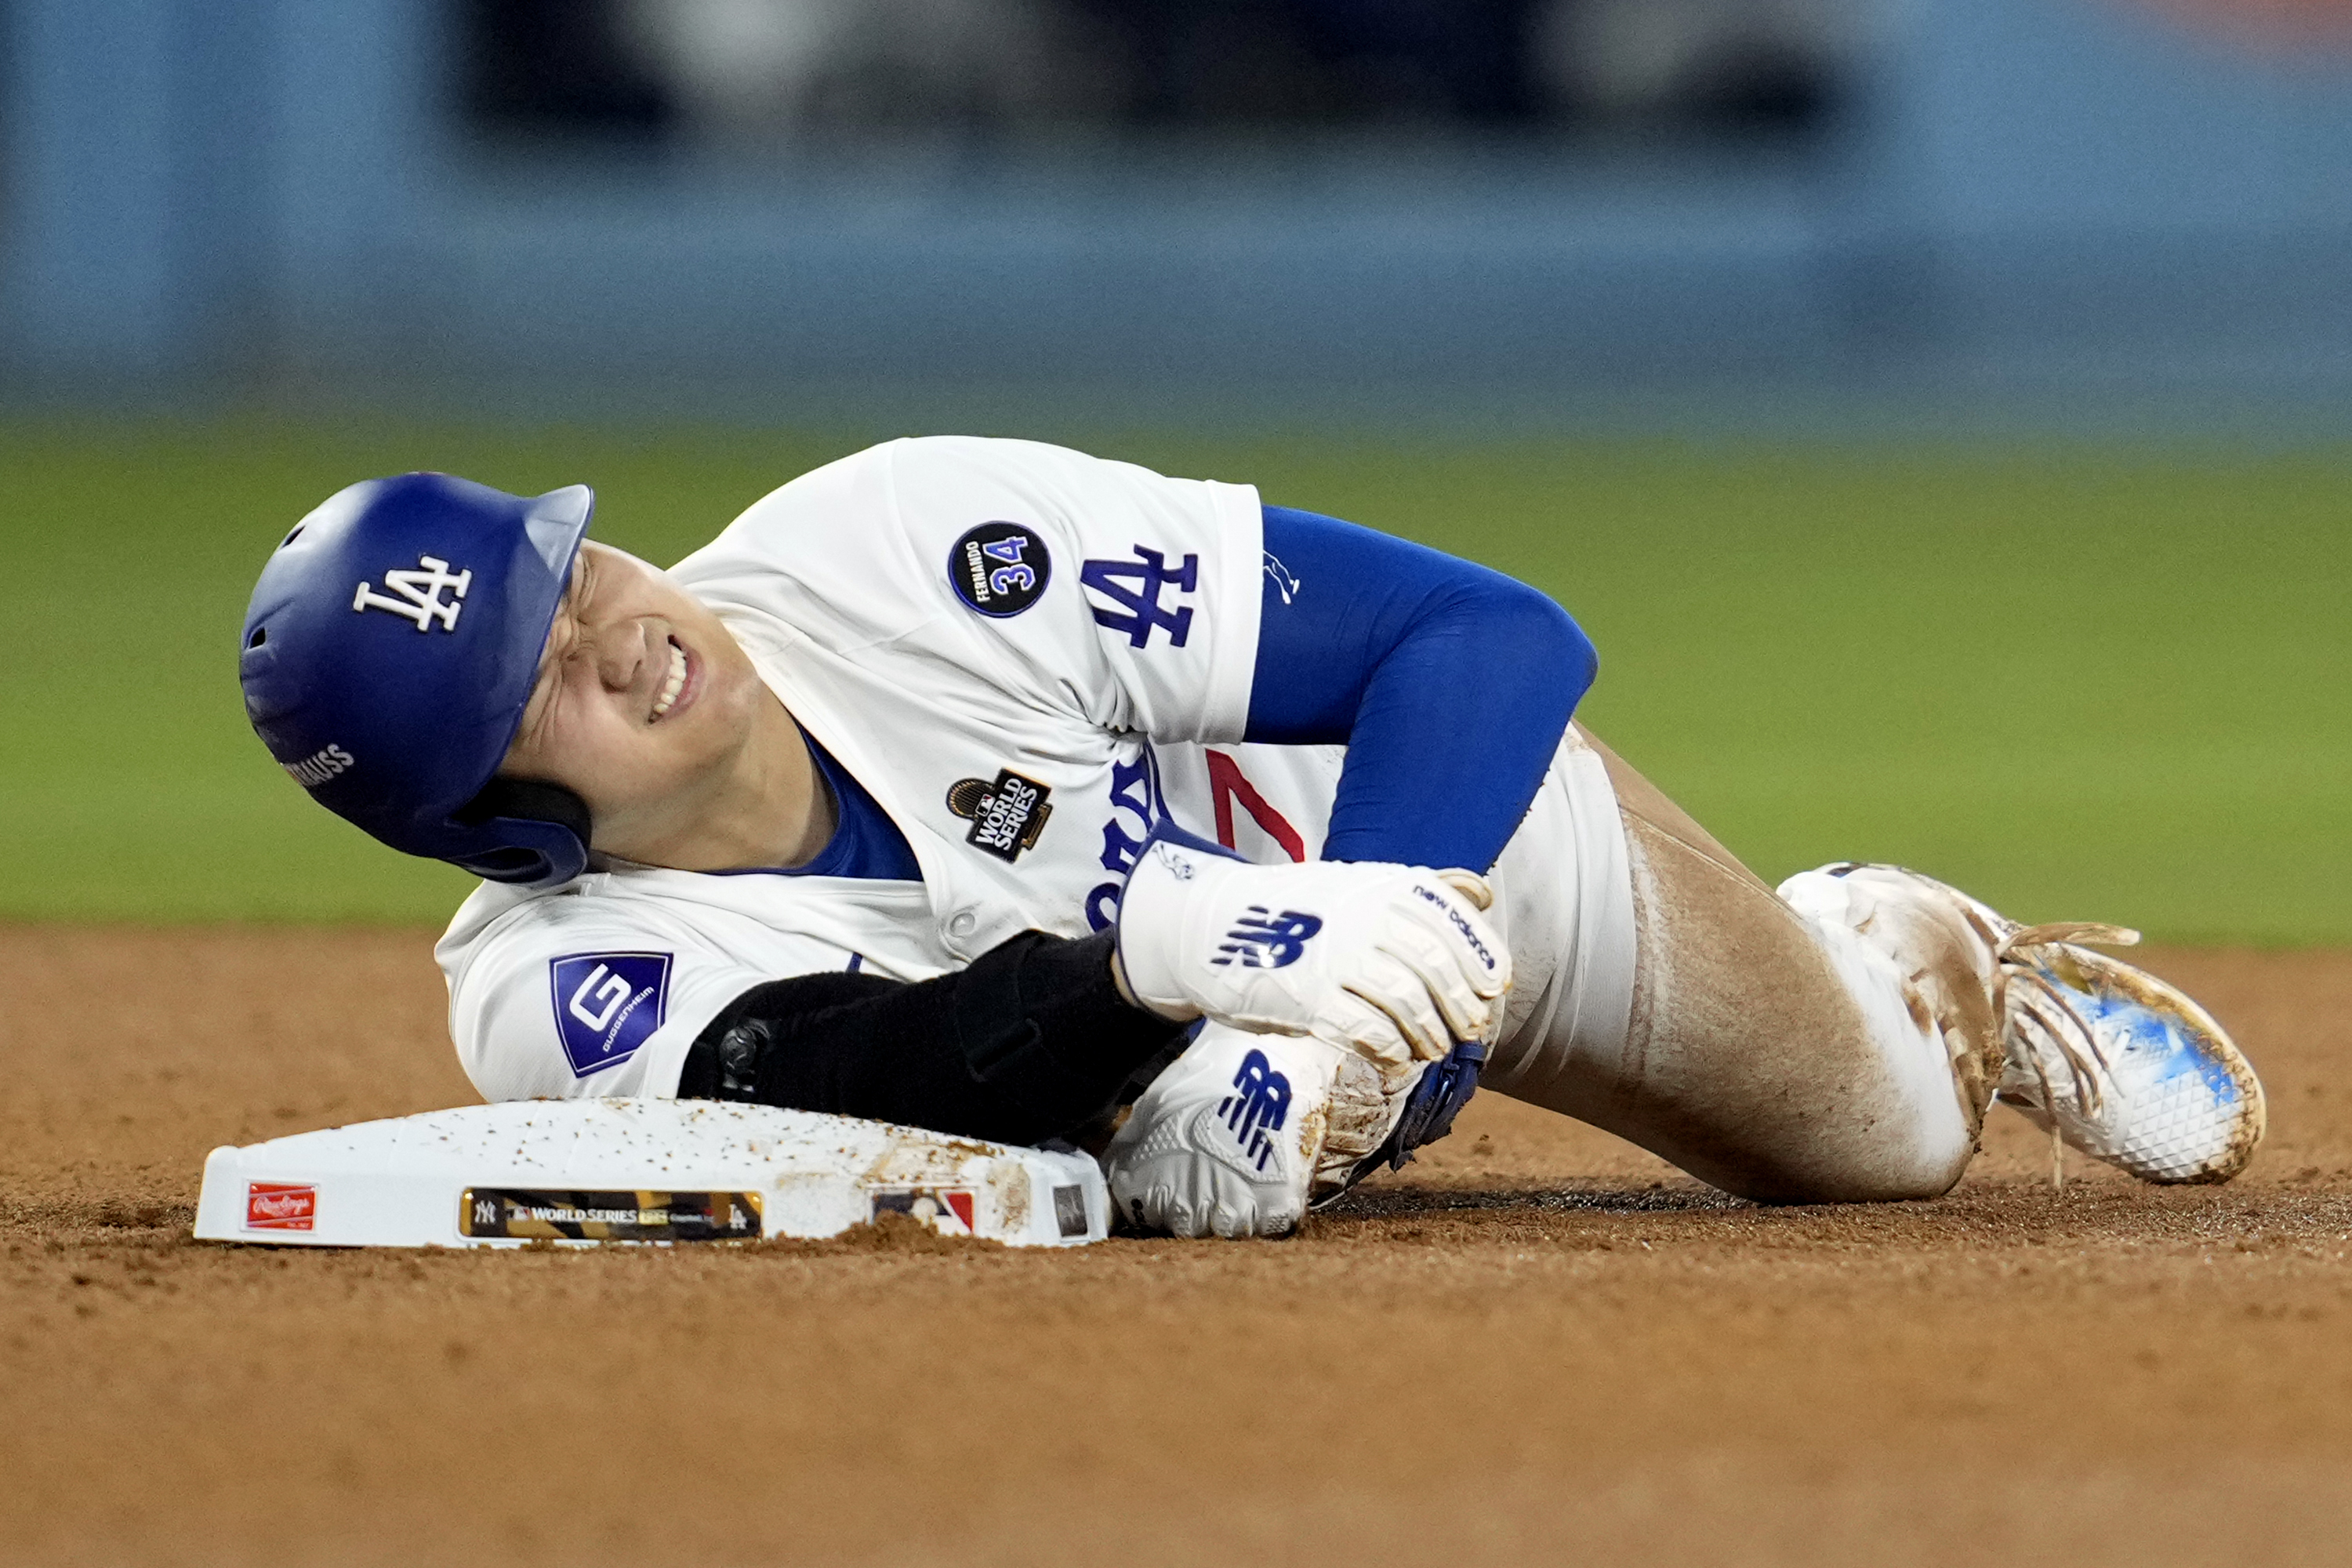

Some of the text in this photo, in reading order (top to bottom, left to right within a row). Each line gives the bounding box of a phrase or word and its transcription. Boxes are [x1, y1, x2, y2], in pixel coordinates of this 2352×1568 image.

[354, 555, 472, 632] LA
[965, 540, 991, 602] FERNANDO
[982, 535, 1036, 595] 34
[1080, 543, 1199, 649] LA
[975, 778, 1022, 844] WORLD
[993, 786, 1038, 851] SERIES
[1205, 748, 1305, 863] 7
[1413, 884, 1496, 970] new balance
[569, 963, 632, 1032] G
[602, 986, 655, 1052] GUGGENHEIM
[531, 1207, 586, 1222] WORLD
[586, 1208, 637, 1225] SERIES
